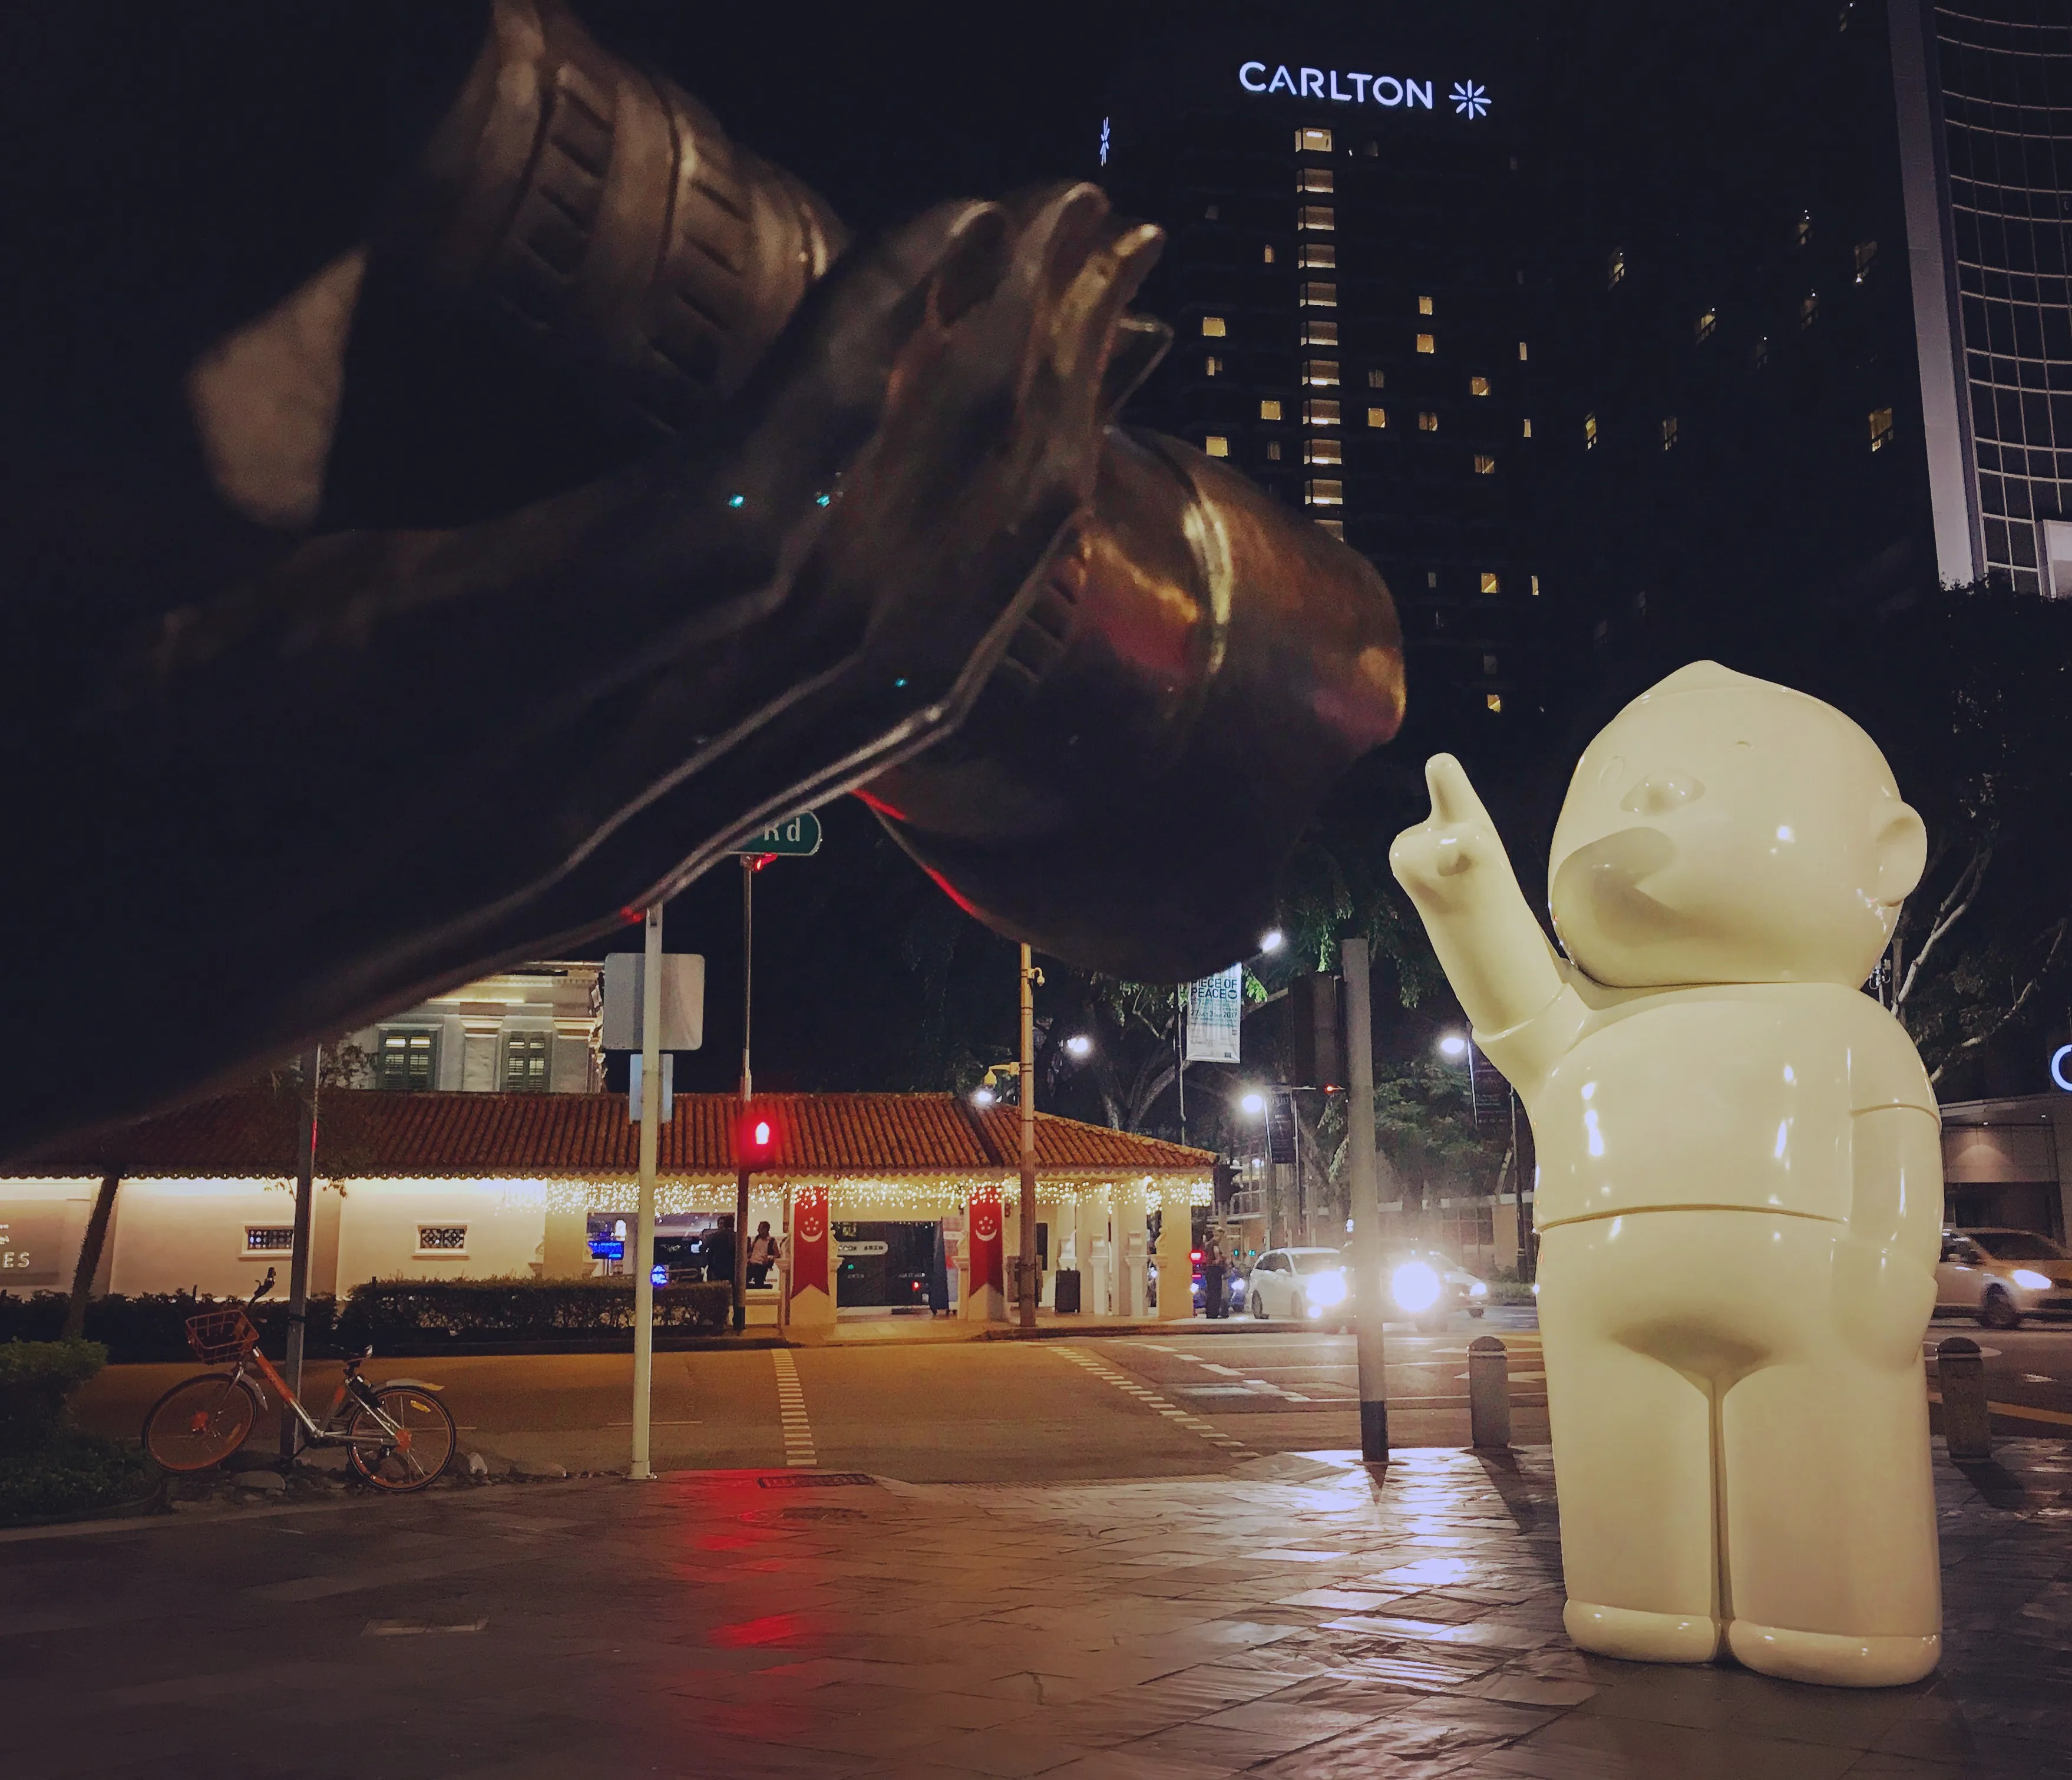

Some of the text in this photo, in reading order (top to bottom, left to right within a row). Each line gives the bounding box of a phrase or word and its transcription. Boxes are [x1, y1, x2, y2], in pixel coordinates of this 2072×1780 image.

[1239, 61, 1433, 110] CARLTON
[764, 817, 800, 841] Rd
[1191, 978, 1237, 989] PIECE OF
[1191, 988, 1227, 999] PEACE
